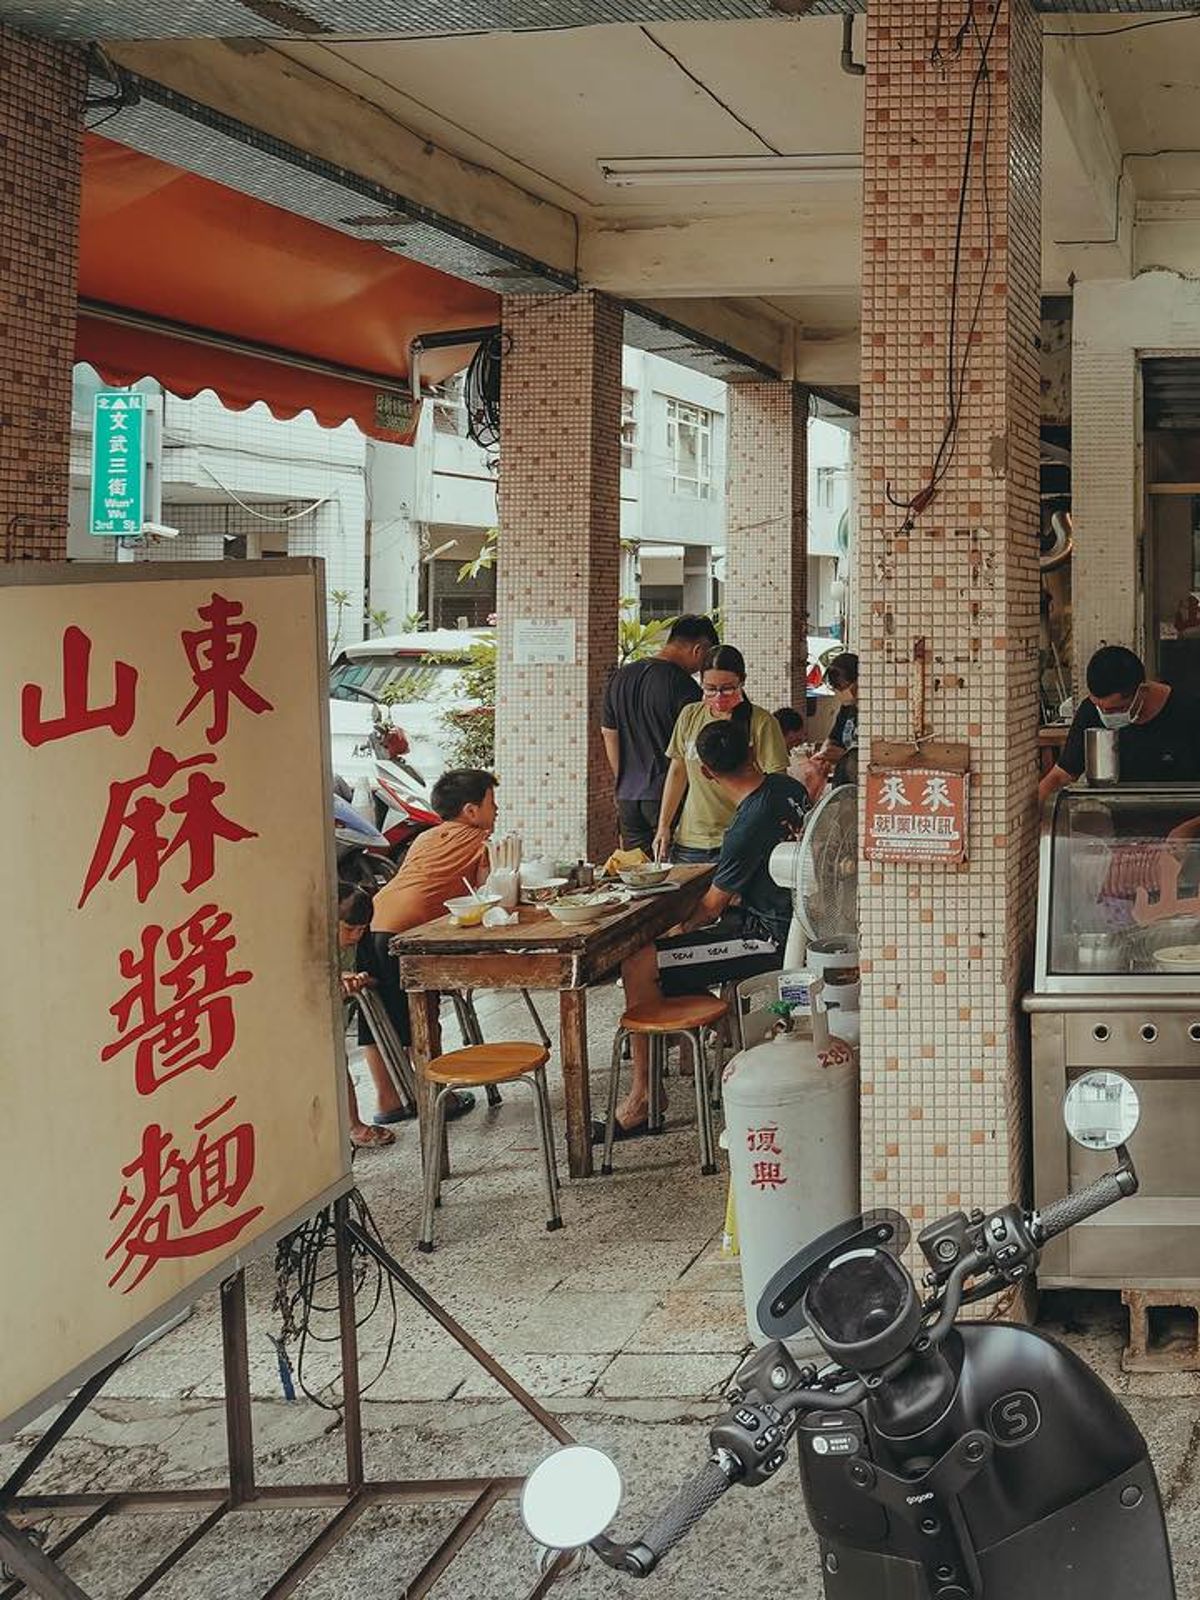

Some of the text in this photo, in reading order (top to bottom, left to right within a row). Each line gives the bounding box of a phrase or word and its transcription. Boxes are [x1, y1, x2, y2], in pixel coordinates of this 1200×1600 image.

[107, 411, 128, 496] 文武三街
[94, 520, 114, 530] 3rd
[107, 509, 127, 518] Wu
[21, 592, 273, 747] 山東
[877, 776, 956, 812] 來來
[875, 815, 953, 835] 就業快訊
[78, 745, 265, 1294] 麻醬麵
